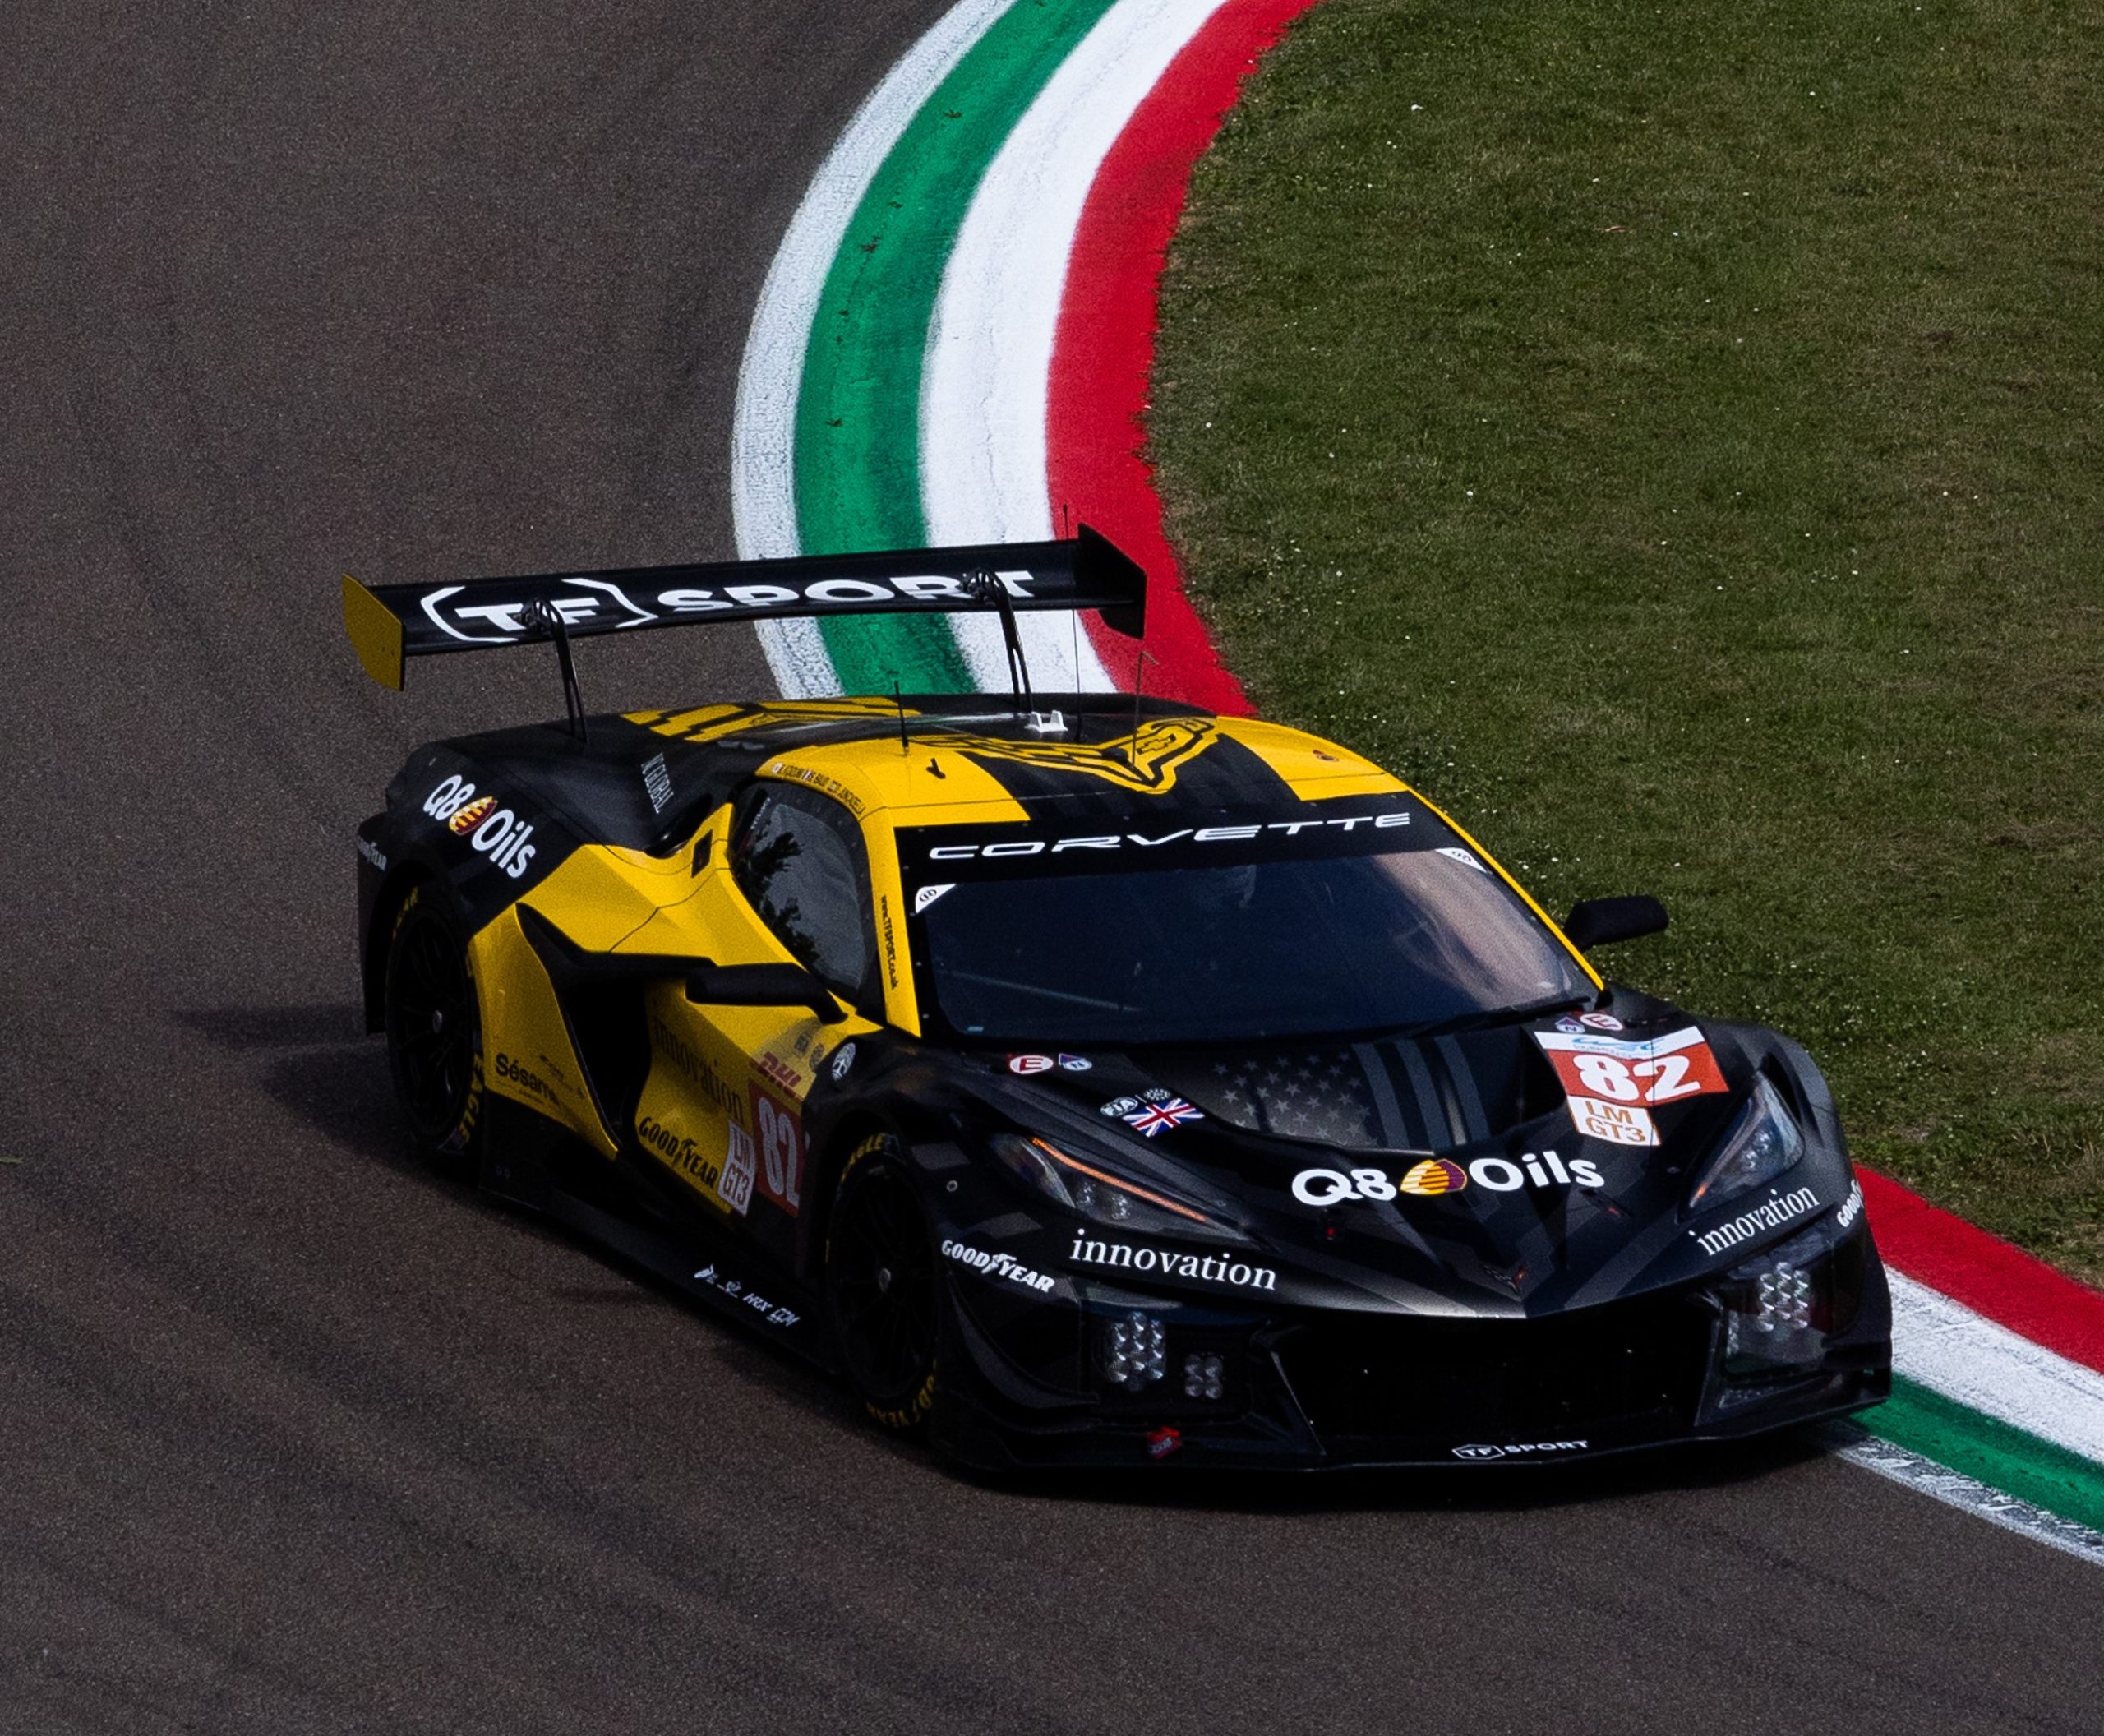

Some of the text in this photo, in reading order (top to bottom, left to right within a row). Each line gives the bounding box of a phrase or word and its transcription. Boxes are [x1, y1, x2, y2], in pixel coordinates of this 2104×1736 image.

[455, 570, 1036, 632] TF SPORT
[422, 773, 537, 880] Q8 Oils
[929, 811, 1410, 861] CORVETTE
[1572, 1054, 1701, 1102] 82
[1585, 1101, 1634, 1125] LM
[1585, 1116, 1645, 1143] GT3
[639, 1116, 719, 1189] GOODYEAR
[758, 1097, 801, 1210] 82
[1292, 1150, 1606, 1207] Q8 Oils
[724, 1162, 750, 1206] GT3
[1687, 1185, 1820, 1273] innovation
[940, 1238, 1056, 1294] GOODYEAR
[1070, 1227, 1277, 1291] innovation
[1503, 1439, 1590, 1454] SPORT
